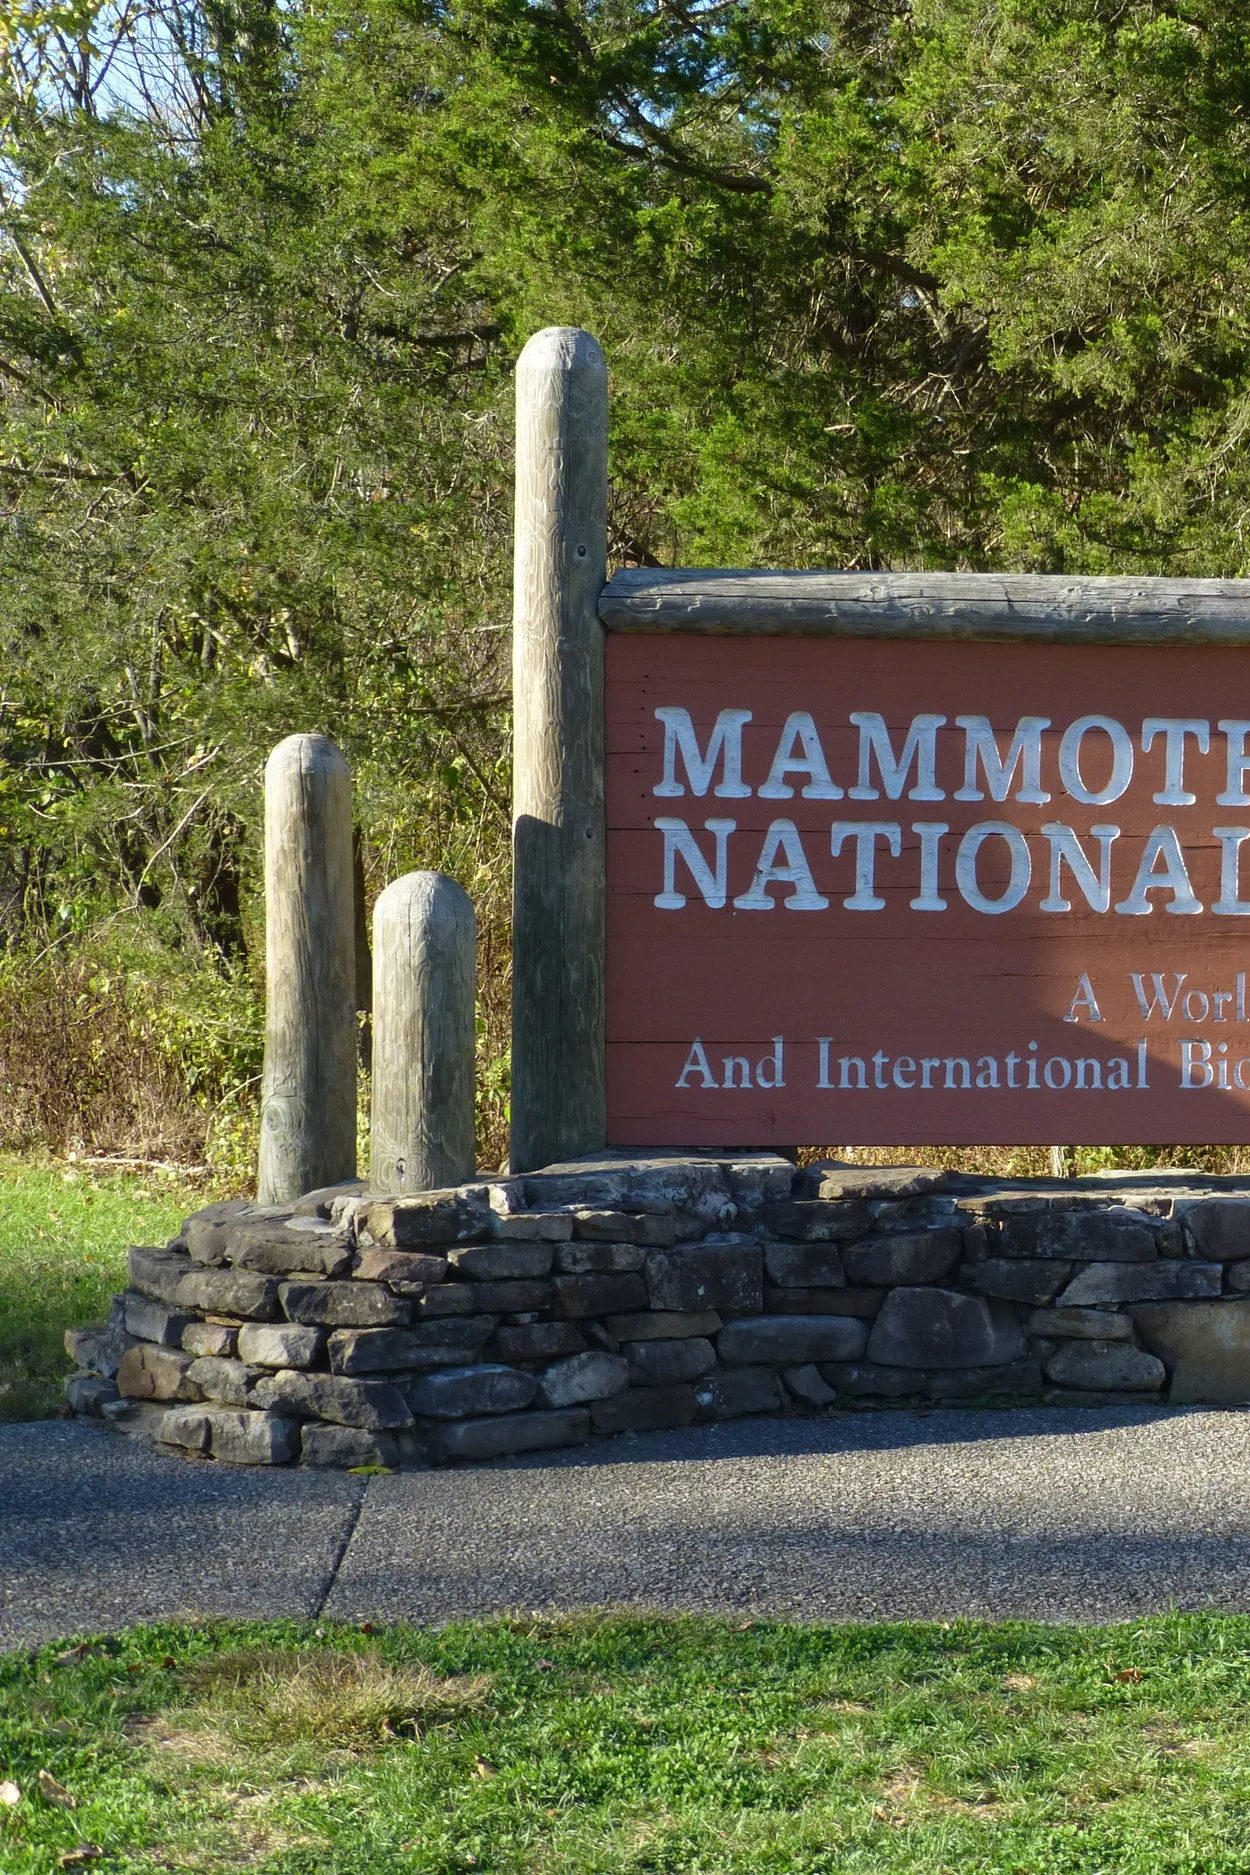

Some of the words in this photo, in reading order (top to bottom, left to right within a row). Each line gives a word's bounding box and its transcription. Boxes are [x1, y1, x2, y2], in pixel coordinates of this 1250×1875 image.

[1063, 972, 1106, 1022] A
[675, 1035, 787, 1089] And
[815, 1036, 1150, 1089] International
